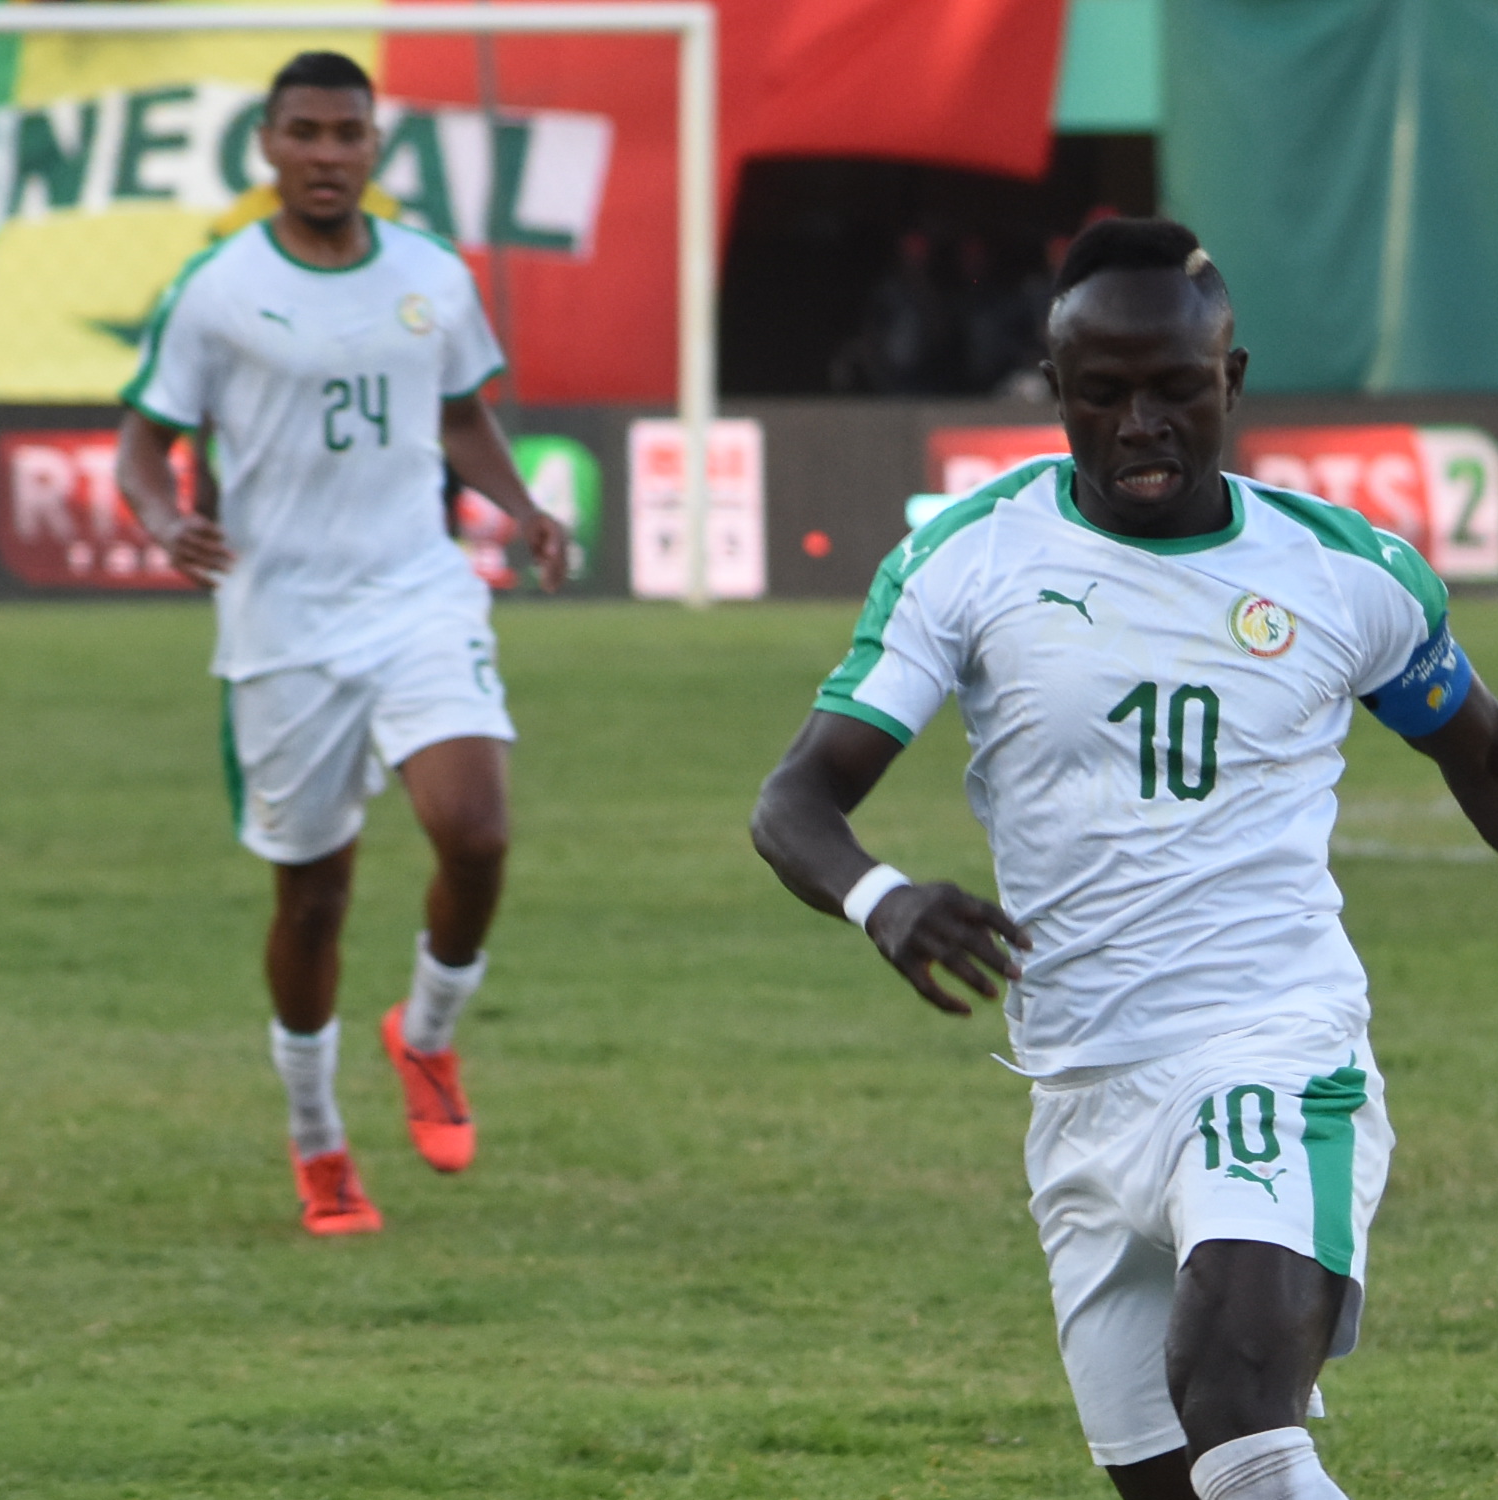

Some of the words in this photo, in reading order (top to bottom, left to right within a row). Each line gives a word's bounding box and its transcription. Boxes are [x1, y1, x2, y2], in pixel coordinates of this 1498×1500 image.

[323, 373, 389, 451] 24
[1107, 681, 1220, 802] 10
[1192, 1084, 1281, 1170] 10
